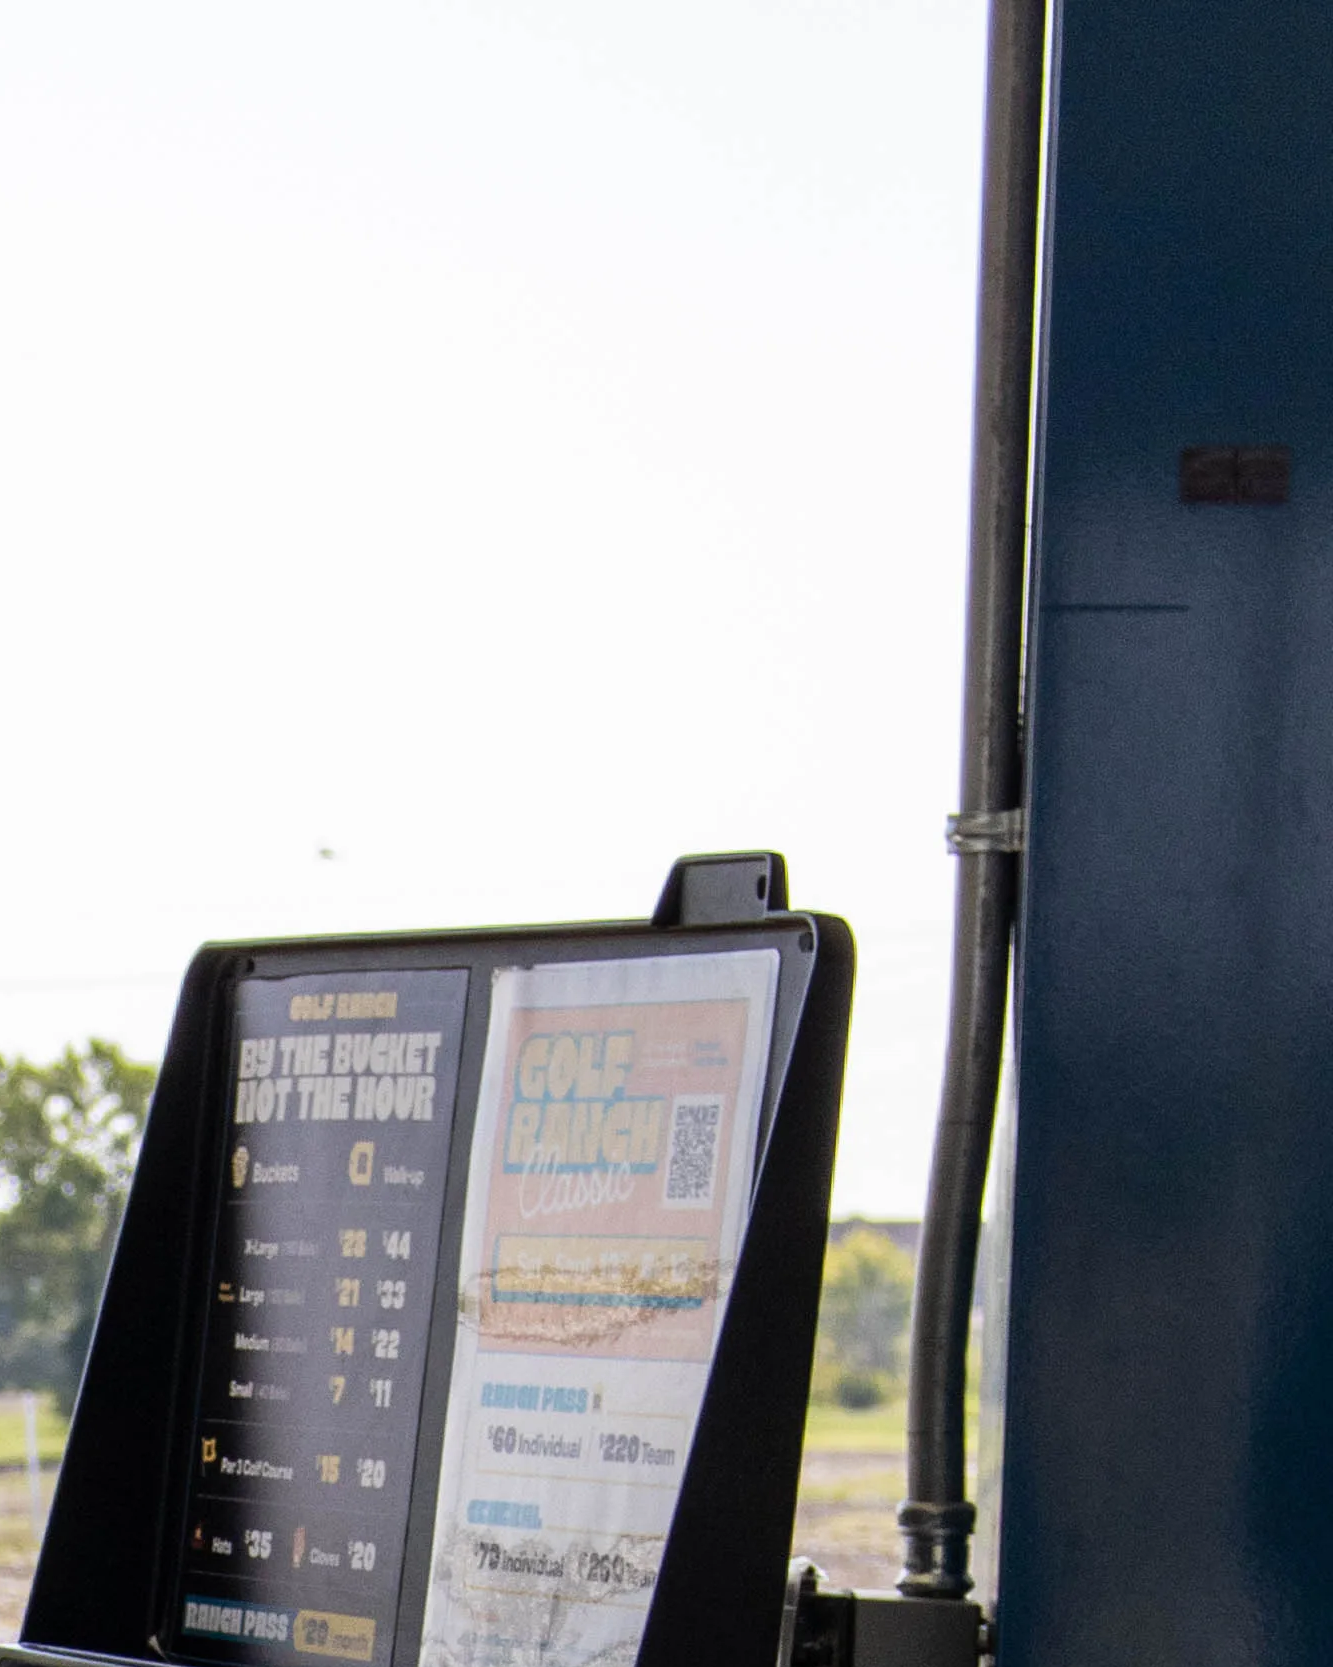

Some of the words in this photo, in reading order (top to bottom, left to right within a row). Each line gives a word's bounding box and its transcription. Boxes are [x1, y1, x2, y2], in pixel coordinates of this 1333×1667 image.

[239, 1037, 276, 1078] BY
[280, 1034, 332, 1076] THE
[332, 1031, 442, 1075] BUCKET
[515, 1031, 636, 1099] GOLF
[235, 1078, 292, 1123] NOT
[297, 1076, 353, 1121] THE
[353, 1075, 436, 1122] HOUR
[504, 1098, 665, 1172] RANCH
[252, 1162, 300, 1184] Buckets
[518, 1139, 638, 1220] Classic
[382, 1230, 412, 1260] $44
[239, 1287, 265, 1307] Large
[371, 1328, 401, 1359] $22
[369, 1378, 393, 1408] $11
[480, 1382, 541, 1410] RANCH
[541, 1386, 590, 1414] PASS
[487, 1425, 517, 1455] $60
[518, 1433, 582, 1459] Individual
[599, 1432, 640, 1464] $220
[641, 1443, 676, 1467] Team
[220, 1457, 237, 1474] Par
[356, 1458, 386, 1489] $20
[211, 1537, 233, 1556] Hats
[244, 1529, 273, 1560] $35
[347, 1540, 377, 1571] $20
[501, 1549, 566, 1579] Individual
[184, 1602, 243, 1636] RANCH
[243, 1610, 290, 1642] PASS
